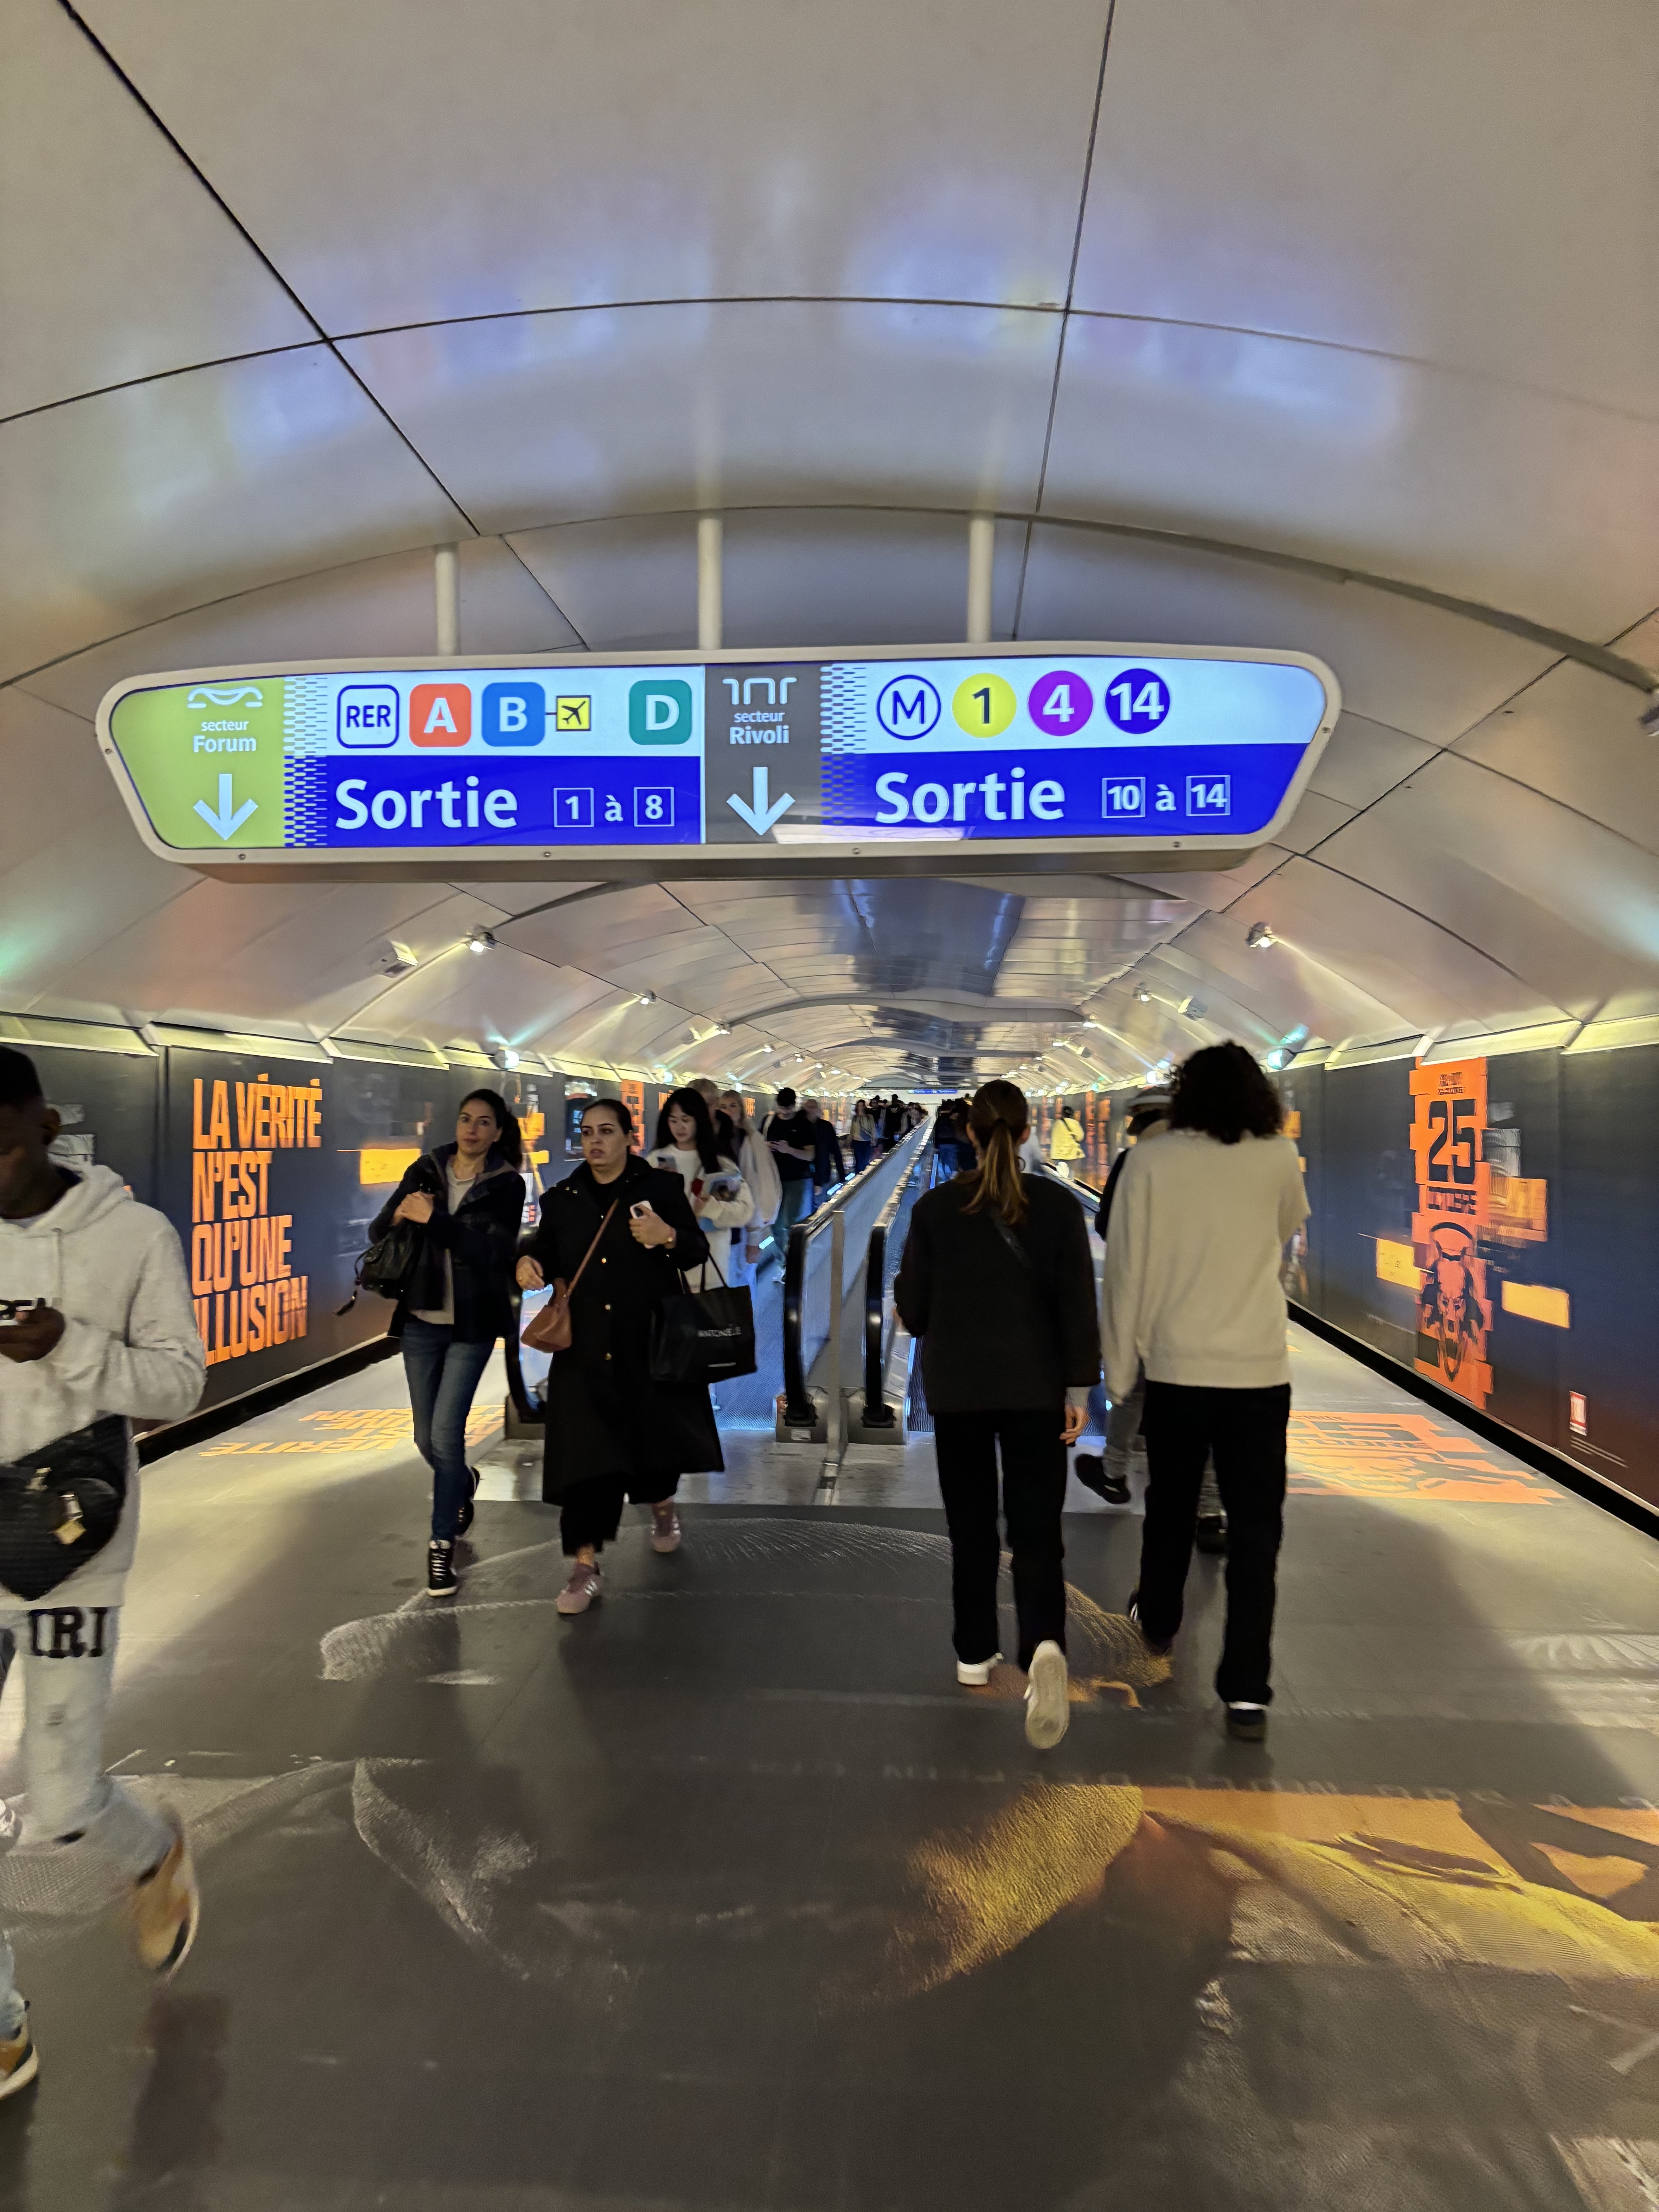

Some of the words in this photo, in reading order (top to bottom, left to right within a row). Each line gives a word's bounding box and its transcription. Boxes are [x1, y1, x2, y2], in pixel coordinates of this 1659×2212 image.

[200, 720, 249, 732] secteur
[347, 705, 390, 728] RER
[423, 697, 458, 733] A
[500, 697, 527, 732] B
[646, 694, 679, 730] D
[734, 711, 785, 723] secteur
[892, 691, 925, 725] M
[973, 687, 990, 724] 1
[1042, 684, 1075, 723] 4
[1111, 682, 1164, 721] 14
[192, 730, 257, 753] Forum
[730, 725, 789, 744] Rivoli
[335, 776, 518, 830] Sortie
[565, 796, 579, 820] 1
[605, 795, 623, 821] à
[645, 795, 663, 819] 8
[875, 767, 1065, 824] Sortie
[1107, 785, 1140, 811] 10
[1155, 784, 1176, 811] à
[1192, 782, 1226, 809] 14
[193, 1078, 231, 1149] LA
[235, 1073, 322, 1148] VÉRITÉ
[1428, 1099, 1476, 1184] 25
[192, 1151, 273, 1223] N'EST
[192, 1215, 292, 1295] QU'UNE
